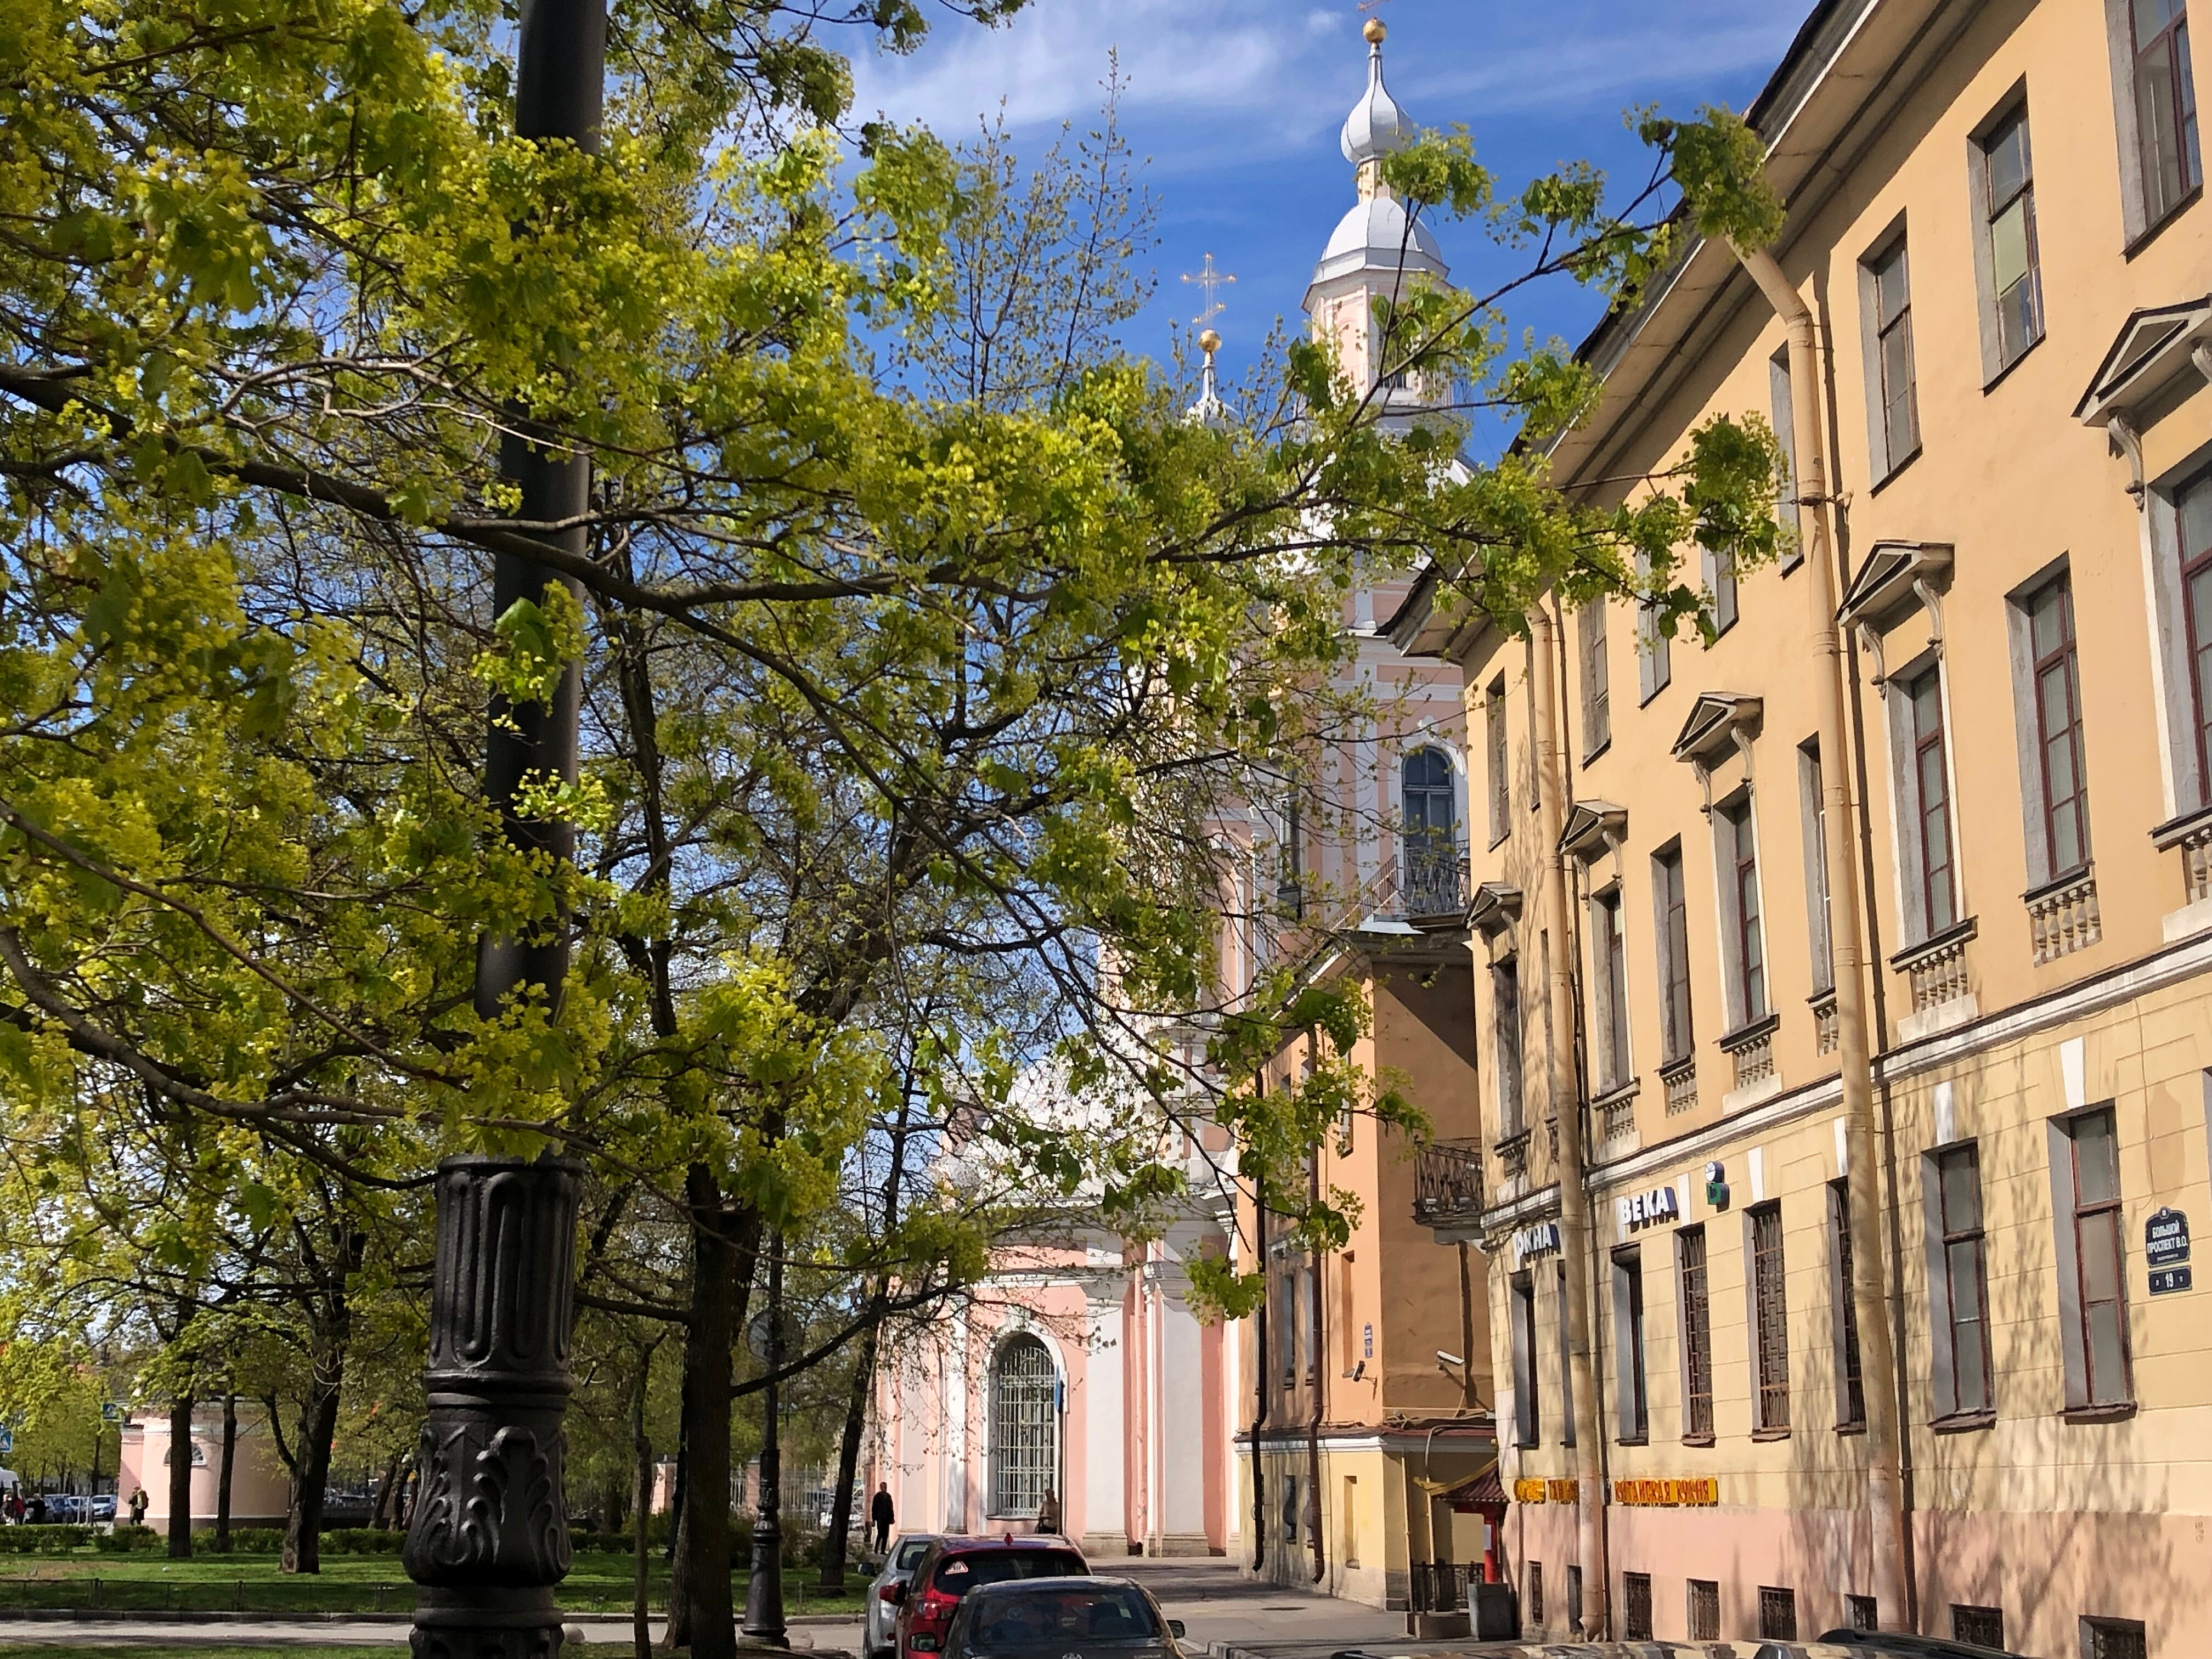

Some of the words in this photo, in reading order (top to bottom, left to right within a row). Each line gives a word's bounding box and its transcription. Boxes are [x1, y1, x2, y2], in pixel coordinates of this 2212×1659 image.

[1516, 1224, 1554, 1256] ОКНА
[1621, 1188, 1670, 1225] ВЕКА
[2165, 1272, 2174, 1288] 19
